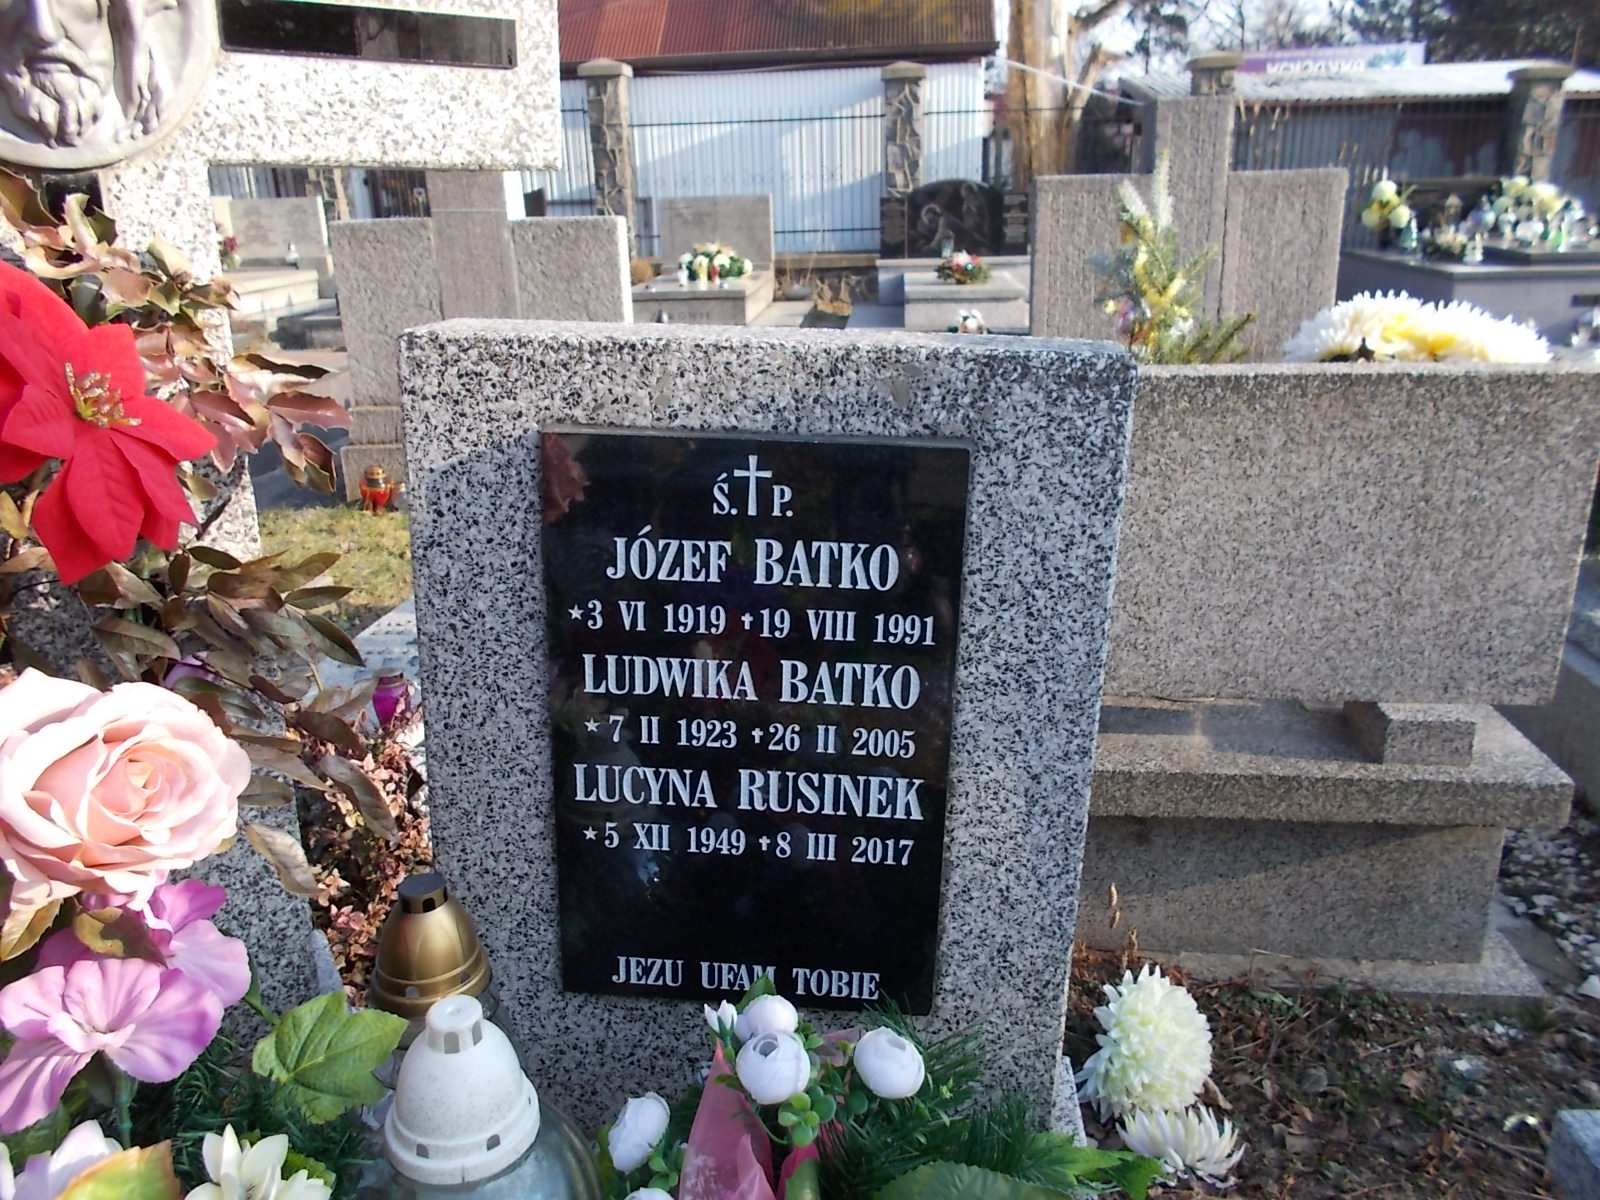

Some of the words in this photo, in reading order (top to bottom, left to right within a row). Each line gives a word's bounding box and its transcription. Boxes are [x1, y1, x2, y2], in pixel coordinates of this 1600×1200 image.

[771, 484, 795, 518] P.
[605, 524, 732, 583] JÓZEF
[753, 538, 900, 592] BATKO
[618, 600, 647, 632] VI
[663, 603, 727, 636] 1919
[759, 607, 792, 639] 19
[806, 609, 857, 642] VIII
[872, 613, 937, 646] 1991
[582, 653, 759, 702] LUDWIKA
[779, 659, 921, 710] BATKO
[639, 715, 661, 745] II
[676, 718, 738, 749] 1923
[768, 722, 801, 752] 26
[815, 724, 838, 755] II
[851, 727, 917, 759] 2005
[573, 763, 718, 808] LUCYNA
[737, 768, 925, 821] RUSINEK
[632, 822, 671, 851] XII
[687, 826, 747, 856] 1949
[806, 832, 838, 862] III
[850, 836, 915, 866] 2017
[611, 955, 684, 987] JEZU
[792, 966, 881, 1000] TOBIE
